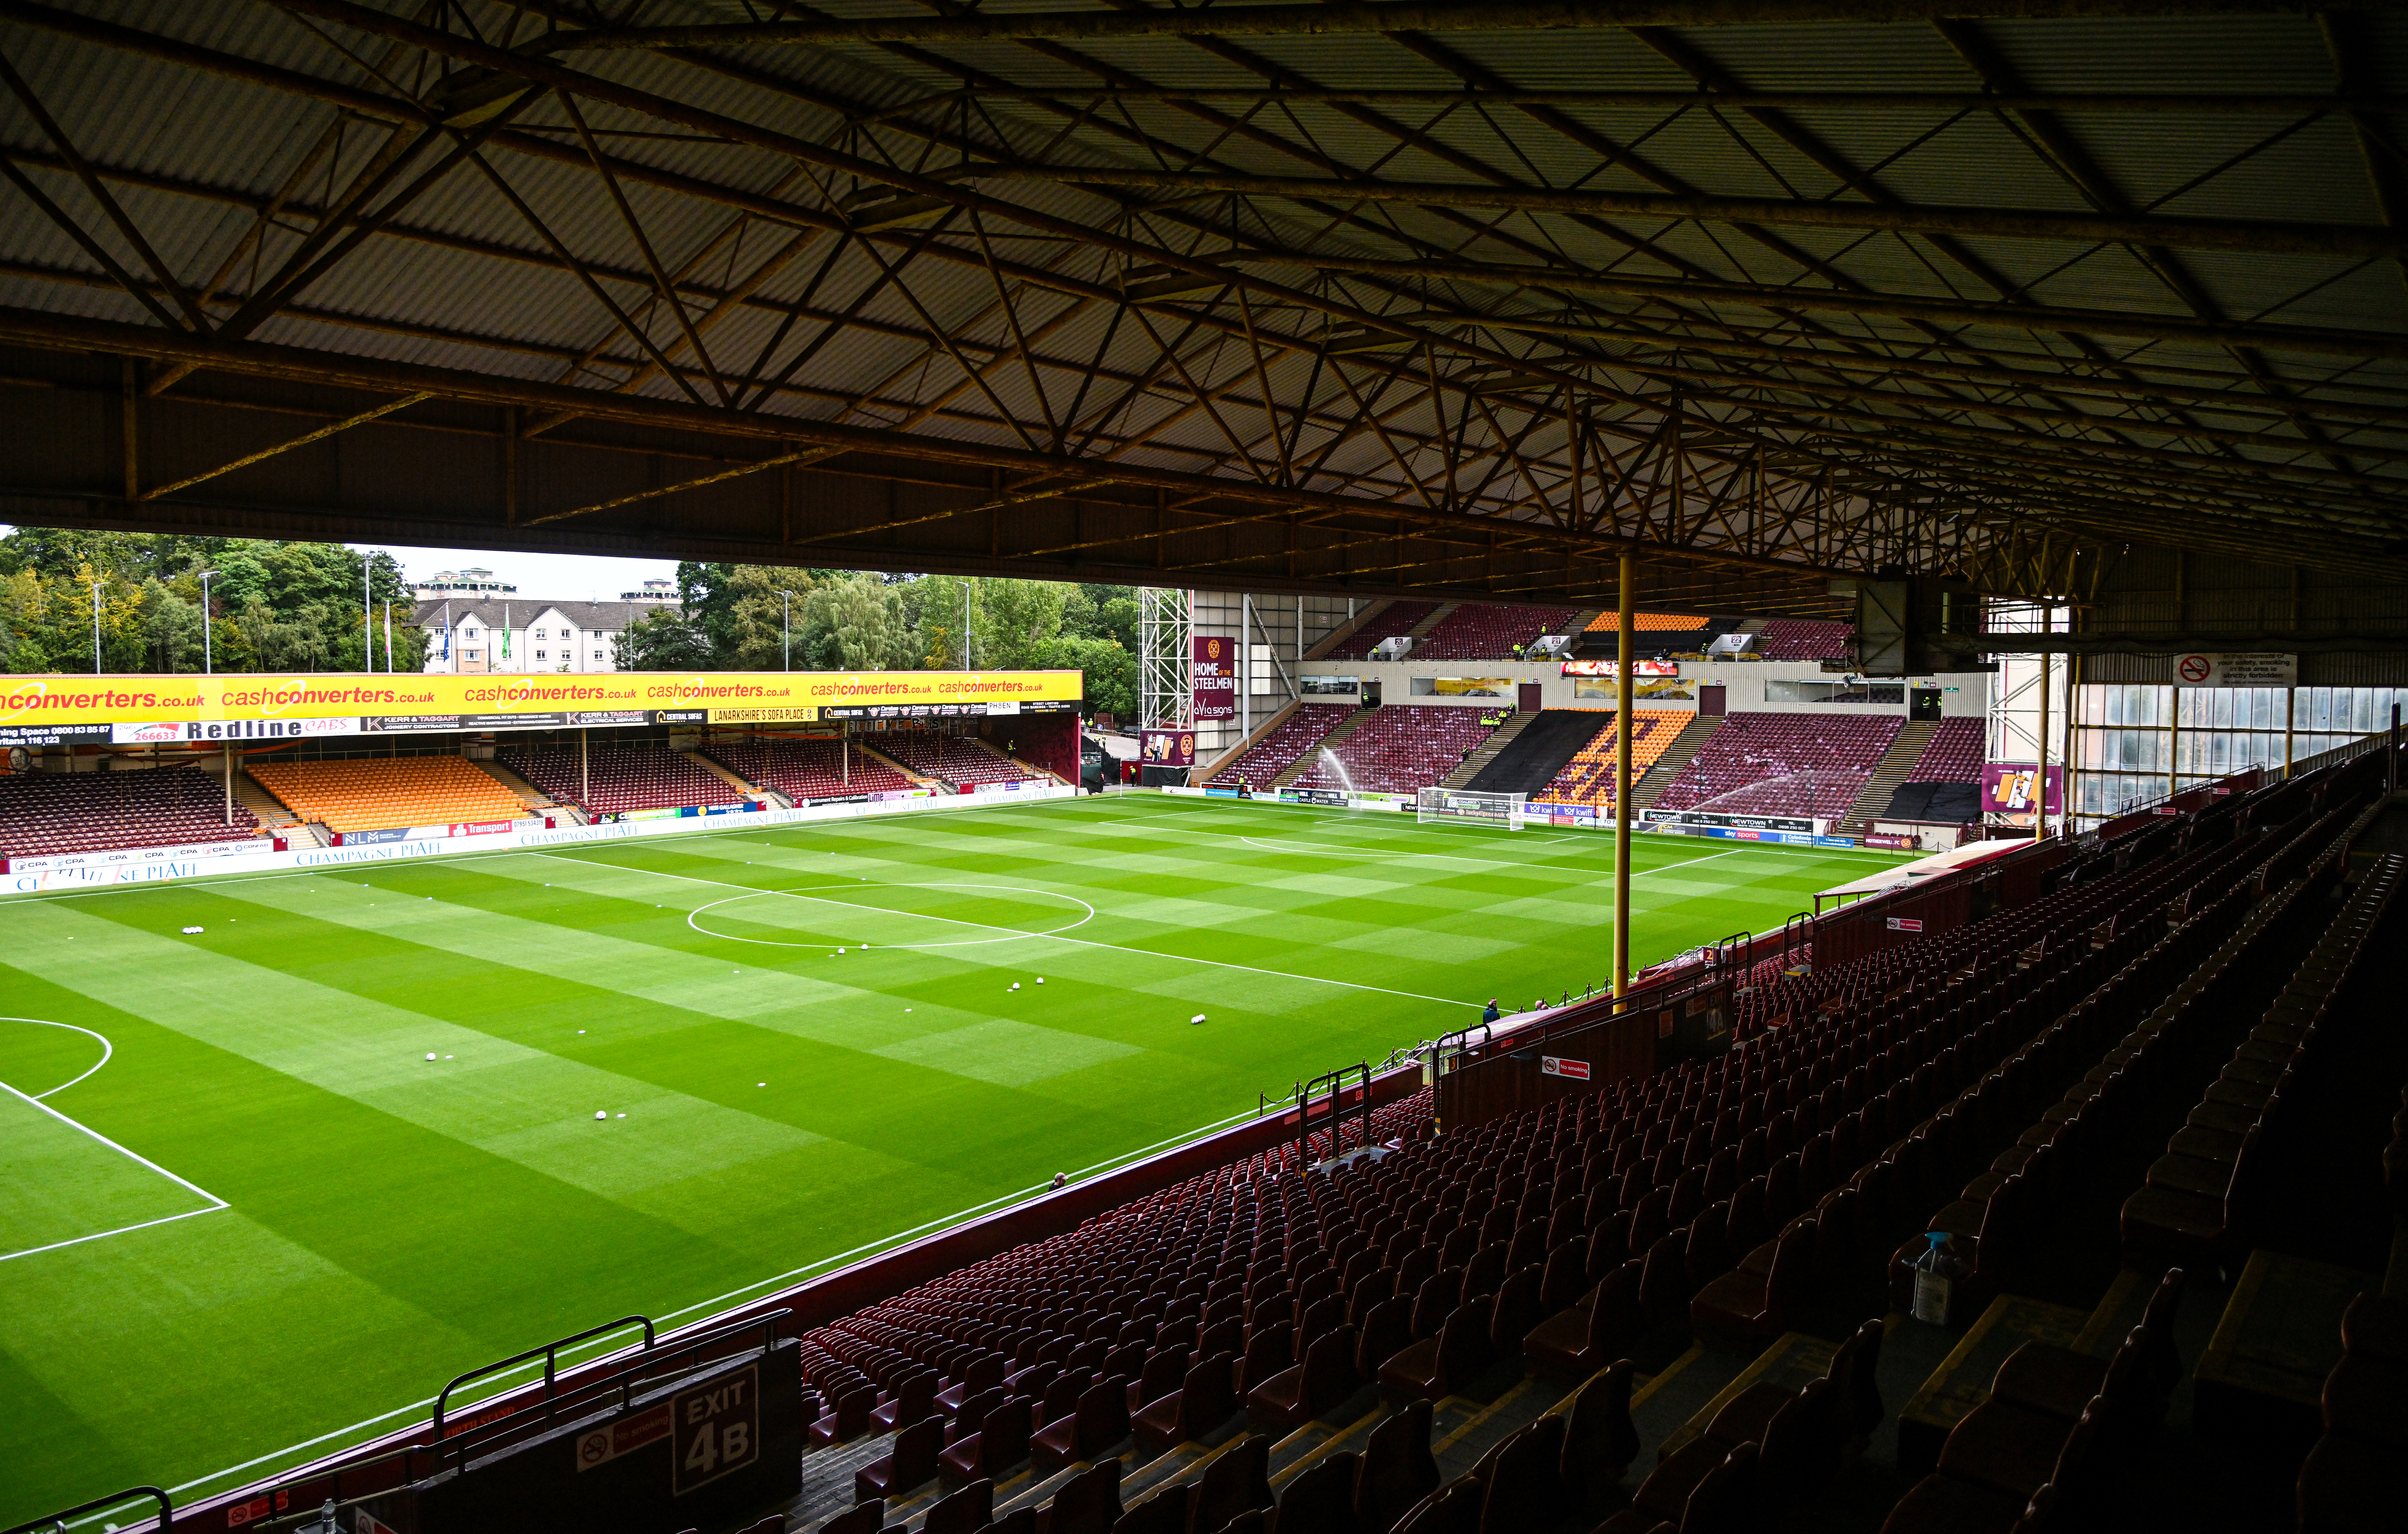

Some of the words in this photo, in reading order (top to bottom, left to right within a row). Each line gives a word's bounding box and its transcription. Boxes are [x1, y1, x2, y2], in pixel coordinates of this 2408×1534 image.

[1194, 663, 1219, 676] HOME
[811, 682, 932, 695] cashconverters.co.uk
[939, 681, 1042, 693] cashconverters.co.uk
[1194, 677, 1232, 690] STEELMEN
[222, 687, 435, 706] cashconverters.co.uk
[465, 685, 637, 701] cashconverters.co.uk
[648, 683, 791, 698] cashconverters.co.uk
[714, 710, 766, 721] LANARKSHIRE'S
[768, 710, 784, 720] SOFA
[785, 709, 804, 720] PLACE
[1213, 706, 1232, 716] signs
[20, 728, 50, 737] Space
[187, 720, 302, 739] Redline
[305, 718, 347, 731] CABS
[135, 732, 176, 741] 266633
[868, 792, 884, 802] Lime
[984, 792, 1035, 804] CHAMPAGNE
[618, 809, 676, 820] CLEARWATER
[1541, 806, 1558, 814] kwiff
[1650, 811, 1682, 820] NEWTOWN
[468, 822, 510, 834] Transport
[704, 815, 770, 829] CHAMPAGNE
[521, 829, 600, 845] CHAMPAGNE
[296, 847, 394, 866] CHAMPAGNE
[1706, 949, 1713, 960] 2
[1451, 1059, 1455, 1069] 3
[1568, 1066, 1588, 1074] smoking
[687, 1379, 746, 1425] EXIT
[631, 1415, 669, 1437] smoking
[685, 1420, 749, 1473] 4B
